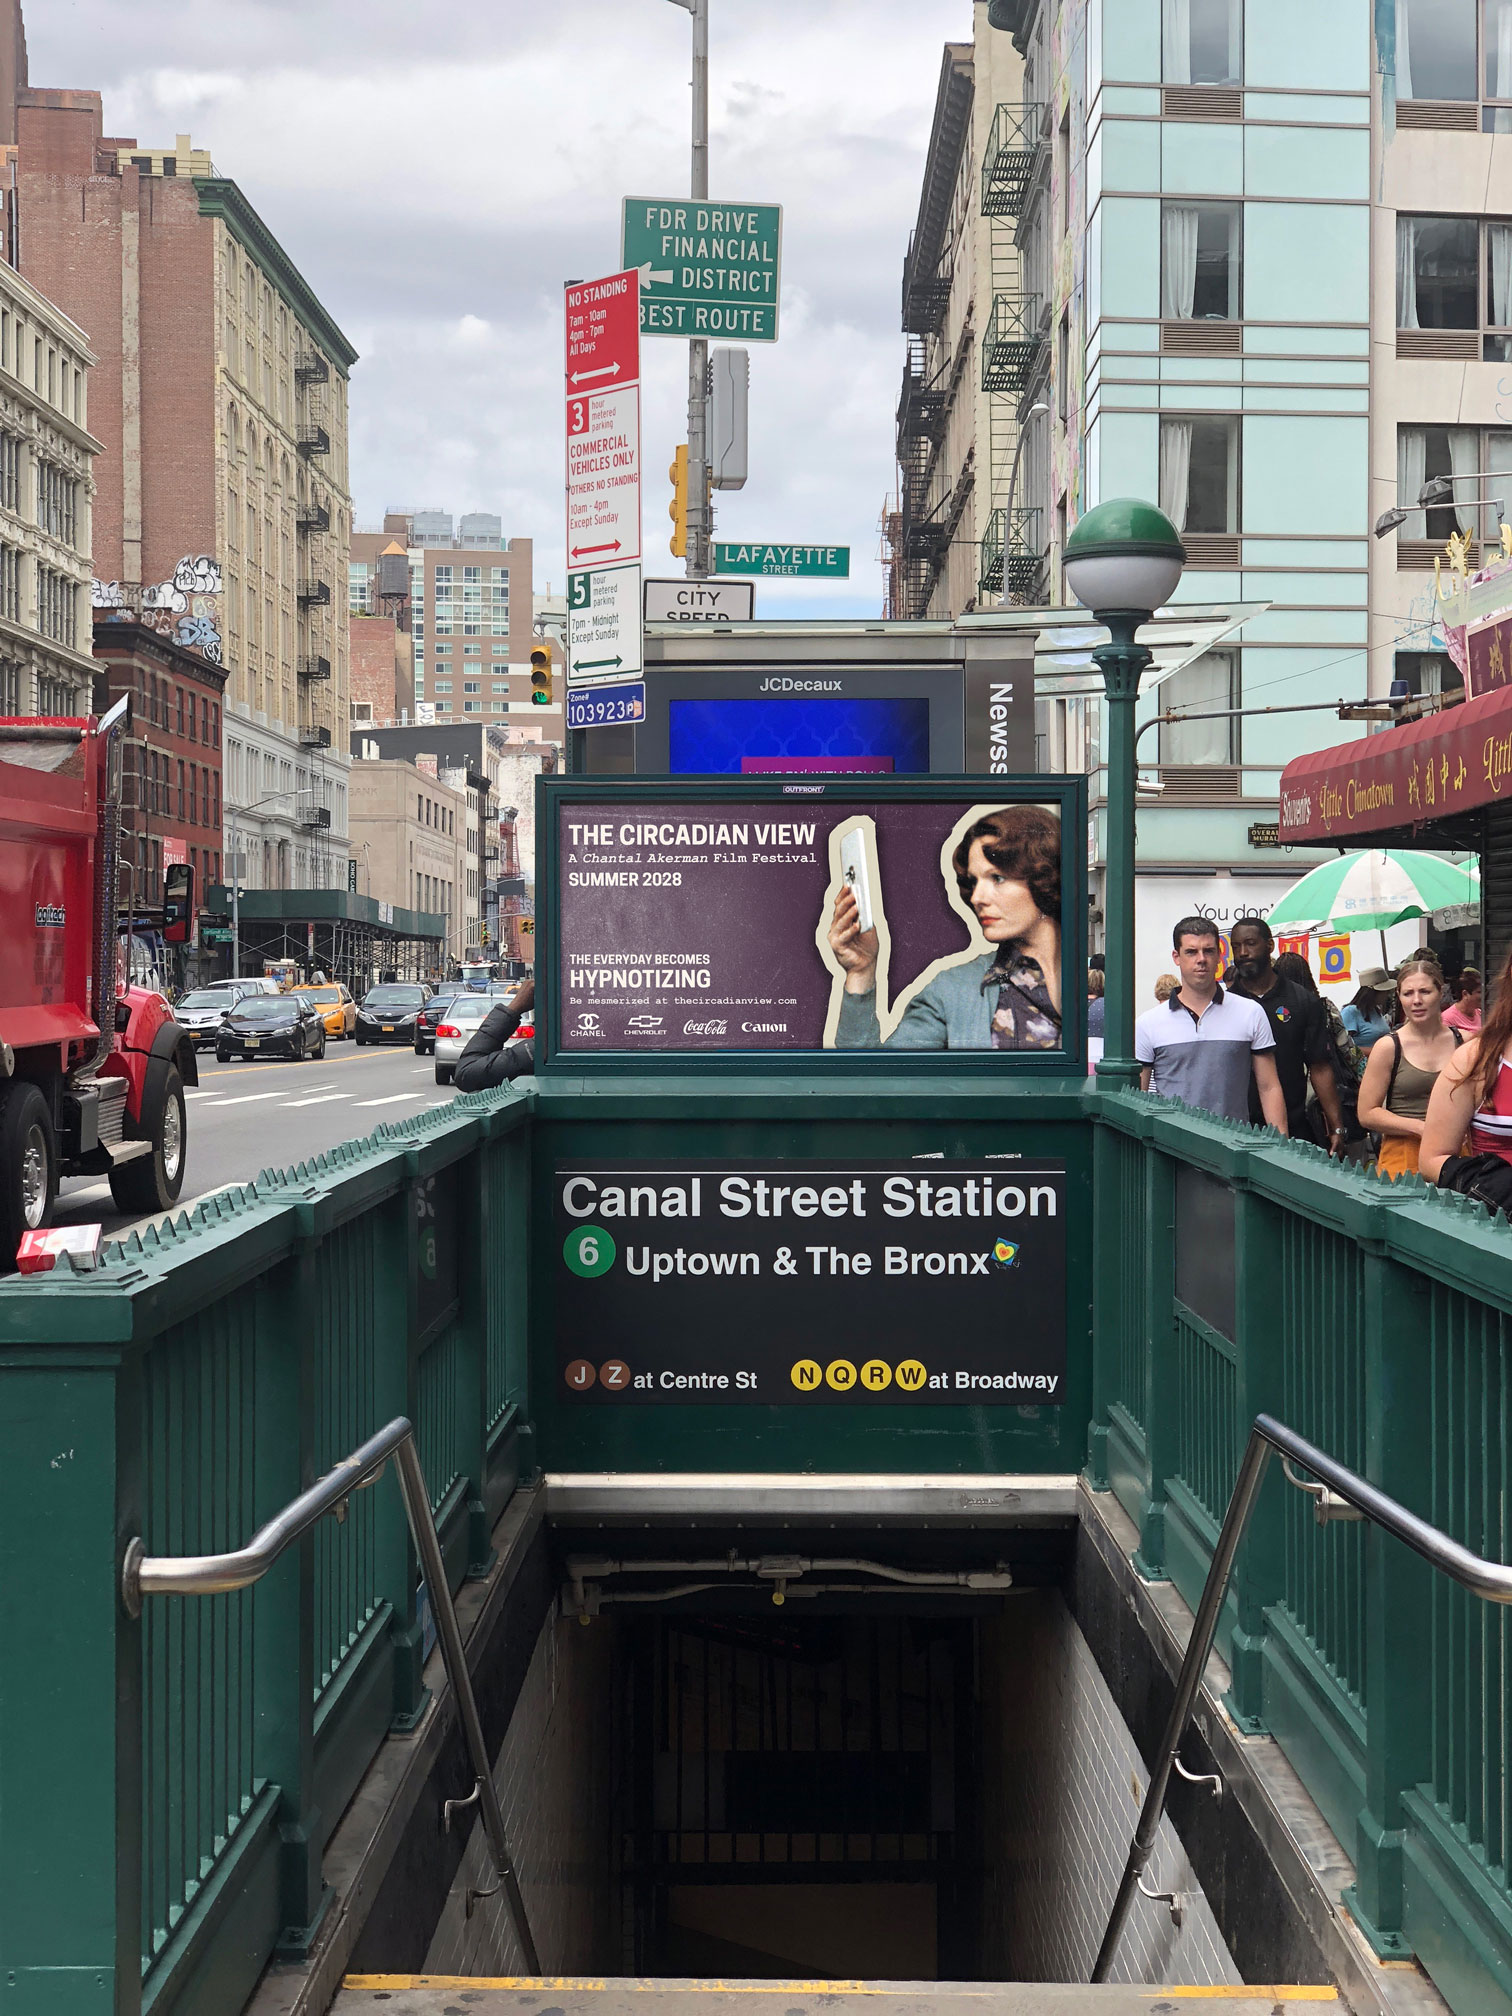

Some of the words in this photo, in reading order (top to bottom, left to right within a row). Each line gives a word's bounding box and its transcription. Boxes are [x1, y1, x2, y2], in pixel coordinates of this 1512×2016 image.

[646, 207, 687, 230] FDR
[697, 210, 758, 234] DRIVE
[662, 236, 774, 262] FINANCIAL
[682, 268, 773, 293] DISTRICT
[569, 292, 581, 307] NO
[583, 279, 627, 304] STANDING
[569, 316, 584, 327] 7am
[589, 309, 607, 323] 10am
[639, 305, 686, 327] BEST
[696, 307, 764, 332] ROUTE
[569, 330, 584, 343] 4pm
[590, 324, 605, 338] 7pm
[570, 344, 578, 356] All
[580, 341, 596, 354] Days
[592, 400, 605, 410] hour
[592, 407, 616, 421] metered
[571, 401, 584, 433] 3
[592, 419, 614, 433] parking
[570, 434, 628, 458] COMMERCIAL
[571, 456, 610, 476] VEHICLES
[613, 450, 635, 469] ONLY
[570, 482, 595, 496] OTHERS
[596, 480, 606, 491] NO
[607, 472, 638, 487] STANDING
[570, 503, 588, 515] 10am
[594, 499, 609, 512] 4pm
[570, 517, 593, 530] Except
[594, 511, 619, 525] Sunday
[724, 545, 837, 565] LAFAYETTE
[762, 565, 800, 575] STREET
[593, 575, 607, 585] hour
[573, 575, 586, 605] 5
[593, 584, 618, 596] metered
[676, 591, 721, 606] CITY
[593, 596, 615, 608] parking
[571, 617, 586, 631] 7pm
[592, 612, 619, 628] Midnight
[666, 611, 730, 620] SPEED
[571, 632, 594, 644] Except
[595, 627, 619, 641] Sunday
[760, 677, 842, 692] JCDecaux
[570, 692, 590, 702] Zone#
[571, 701, 626, 724] 103923
[1320, 784, 1343, 830] Little
[1346, 779, 1394, 819] Chinatown
[568, 824, 614, 846] THE
[619, 823, 748, 846] CIRCADIAN
[754, 824, 816, 846] VIEW
[568, 854, 578, 863] A
[583, 853, 642, 864] Chantal
[647, 853, 708, 864] Akerman
[713, 853, 747, 863] Film
[752, 853, 817, 864] Festival
[568, 872, 639, 887] SUMMER
[642, 872, 682, 887] 2028
[1194, 903, 1229, 921] You
[570, 954, 591, 965] THE
[593, 954, 652, 965] EVERYDAY
[655, 954, 710, 965] BECOMES
[570, 969, 711, 988] HYPNOTIZING
[570, 997, 582, 1005] Be
[588, 997, 650, 1005] mesmerized
[674, 997, 797, 1005] thecircadianview.com
[683, 1019, 729, 1036] Coca-Cola
[741, 1021, 787, 1033] Canon
[562, 1176, 701, 1218] Canal
[719, 1176, 866, 1218] Street
[882, 1176, 1057, 1218] Station
[578, 1237, 599, 1266] 6
[626, 1246, 760, 1283] Uptown
[772, 1246, 798, 1275] &
[805, 1246, 872, 1275] The
[884, 1246, 990, 1275] Bronx
[574, 1366, 586, 1384] J
[608, 1366, 623, 1384] Z
[633, 1372, 654, 1389] at
[659, 1371, 729, 1390] Centre
[735, 1371, 758, 1390] St
[799, 1367, 814, 1384] N
[833, 1366, 850, 1385] Q
[869, 1366, 884, 1384] R
[900, 1367, 922, 1385] W
[928, 1372, 949, 1389] at
[955, 1371, 1059, 1393] Broadway
